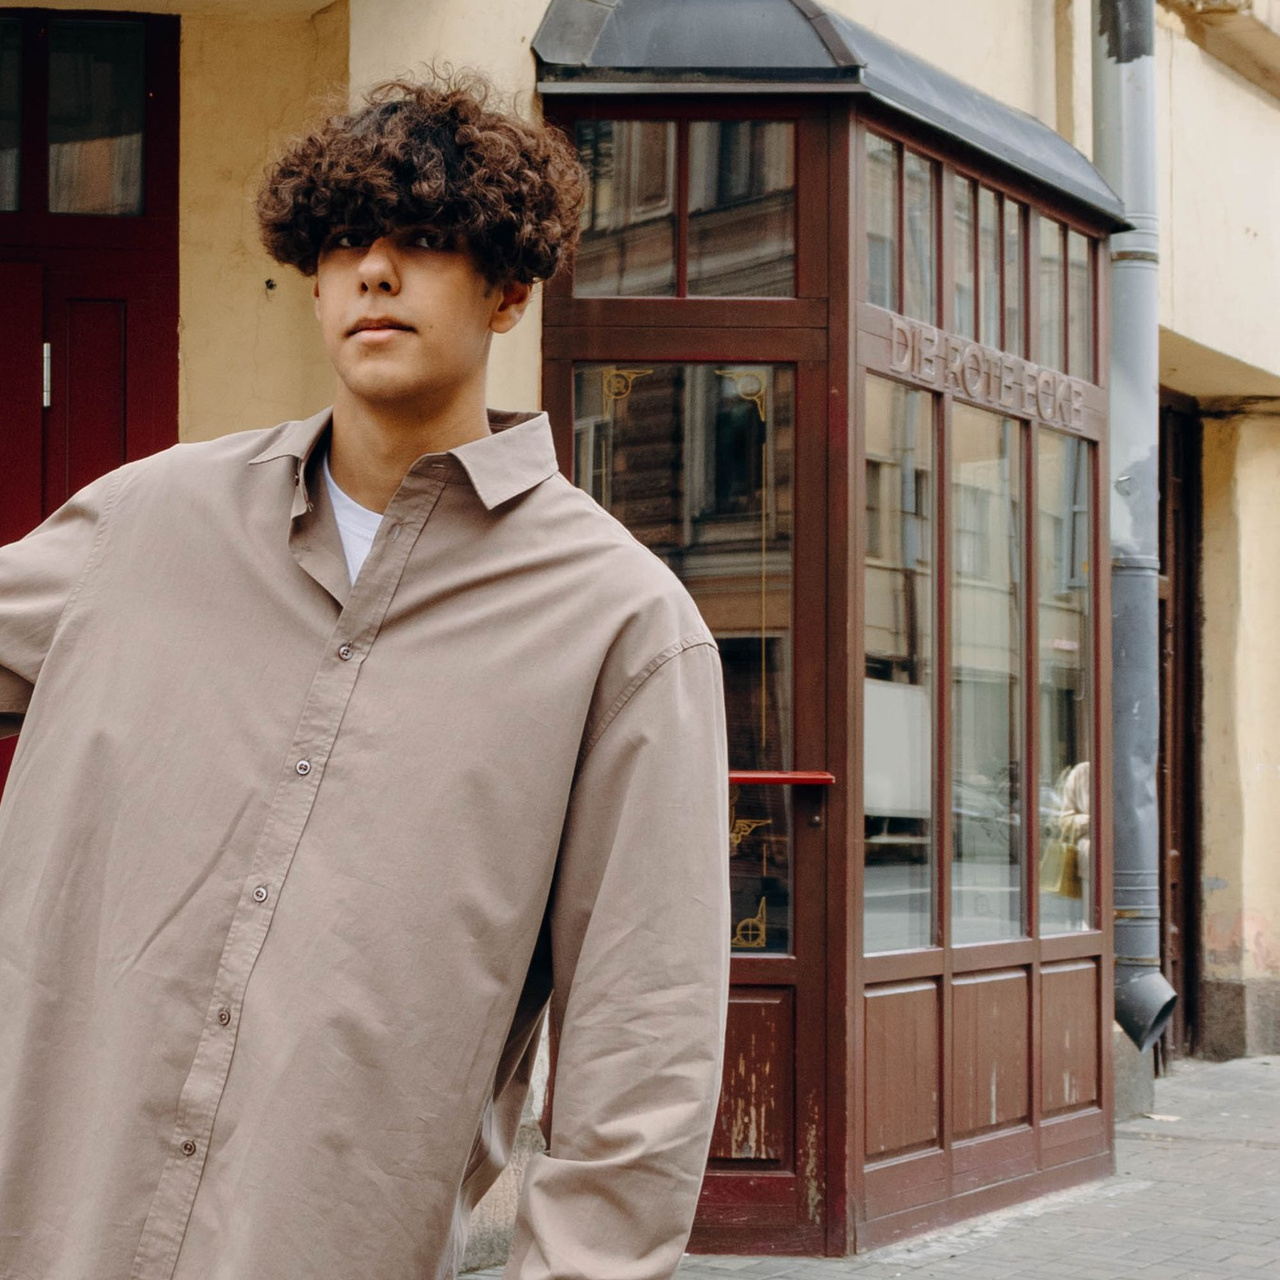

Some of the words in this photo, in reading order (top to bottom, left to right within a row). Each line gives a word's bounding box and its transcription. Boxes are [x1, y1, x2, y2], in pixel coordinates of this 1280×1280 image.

[889, 316, 937, 385] DIE
[944, 335, 1014, 409] ROTE
[1021, 365, 1083, 431] ECKE
